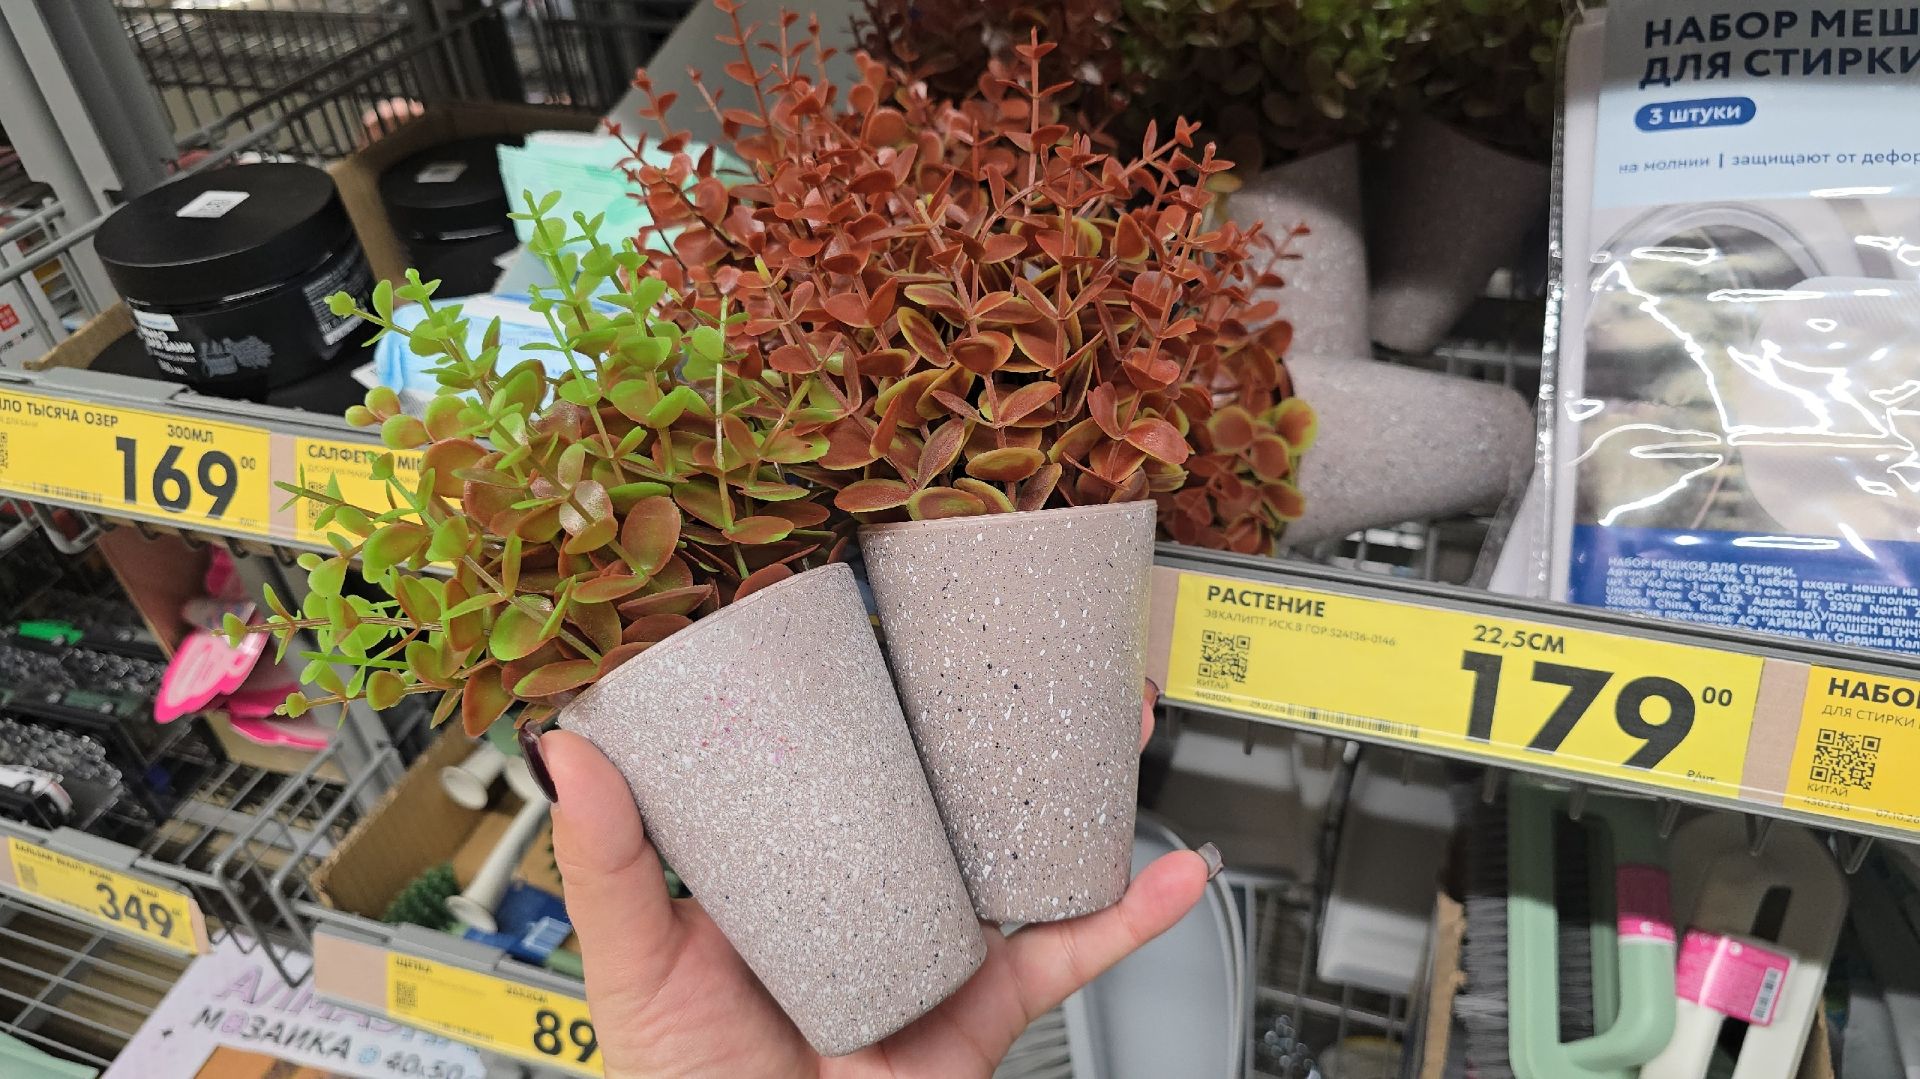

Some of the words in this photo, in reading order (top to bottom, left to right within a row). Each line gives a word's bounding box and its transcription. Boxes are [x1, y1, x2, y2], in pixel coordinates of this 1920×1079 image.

[1644, 10, 1798, 49] НАБОР
[1811, 8, 1919, 38] МЕШ
[1638, 50, 1731, 90] ДЛЯ
[1648, 107, 1663, 126] 3
[1668, 103, 1741, 126] штуки
[1618, 162, 1639, 174] на
[1644, 155, 1710, 172] молнии
[1731, 151, 1830, 168] защищают
[1837, 151, 1857, 165] от
[27, 403, 80, 422] ТЫСЯЧА
[85, 411, 118, 428] ОЗЕР
[167, 424, 214, 444] 300МЛ
[308, 444, 383, 466] САЛФЕТ
[116, 436, 238, 520] 169
[1608, 556, 1650, 567] НАБОР
[1651, 558, 1708, 571] МЕШКОВ
[1710, 561, 1738, 573] ДЛЯ
[1739, 563, 1797, 577] СТИРКИ.
[1606, 568, 1659, 580] Артикул
[1757, 576, 1798, 590] набор
[1802, 579, 1848, 592] входят
[1852, 583, 1898, 595] мешки
[1902, 586, 1919, 596] на
[1207, 585, 1327, 618] РАСТЕНИЕ
[1605, 586, 1642, 597] Union
[1646, 588, 1683, 600] Home
[1751, 596, 1798, 609] Адрес:
[1869, 604, 1907, 617] North
[1824, 591, 1876, 604] Состав:
[1879, 595, 1920, 608] полиэ
[1204, 608, 1267, 625] ЭВКАЛИПТ
[1737, 614, 1759, 626] АО
[1826, 621, 1878, 635] (РАШЕН
[1472, 624, 1566, 655] 22,5СМ
[1196, 678, 1230, 691] КИТАЙ
[1460, 650, 1697, 775] 179
[1702, 686, 1733, 707] 00
[1822, 704, 1852, 718] ДЛЯ
[1856, 709, 1915, 728] СТИРКИ
[1807, 782, 1849, 798] КИТАЙ
[96, 883, 174, 938] 349
[533, 1009, 599, 1064] 89
